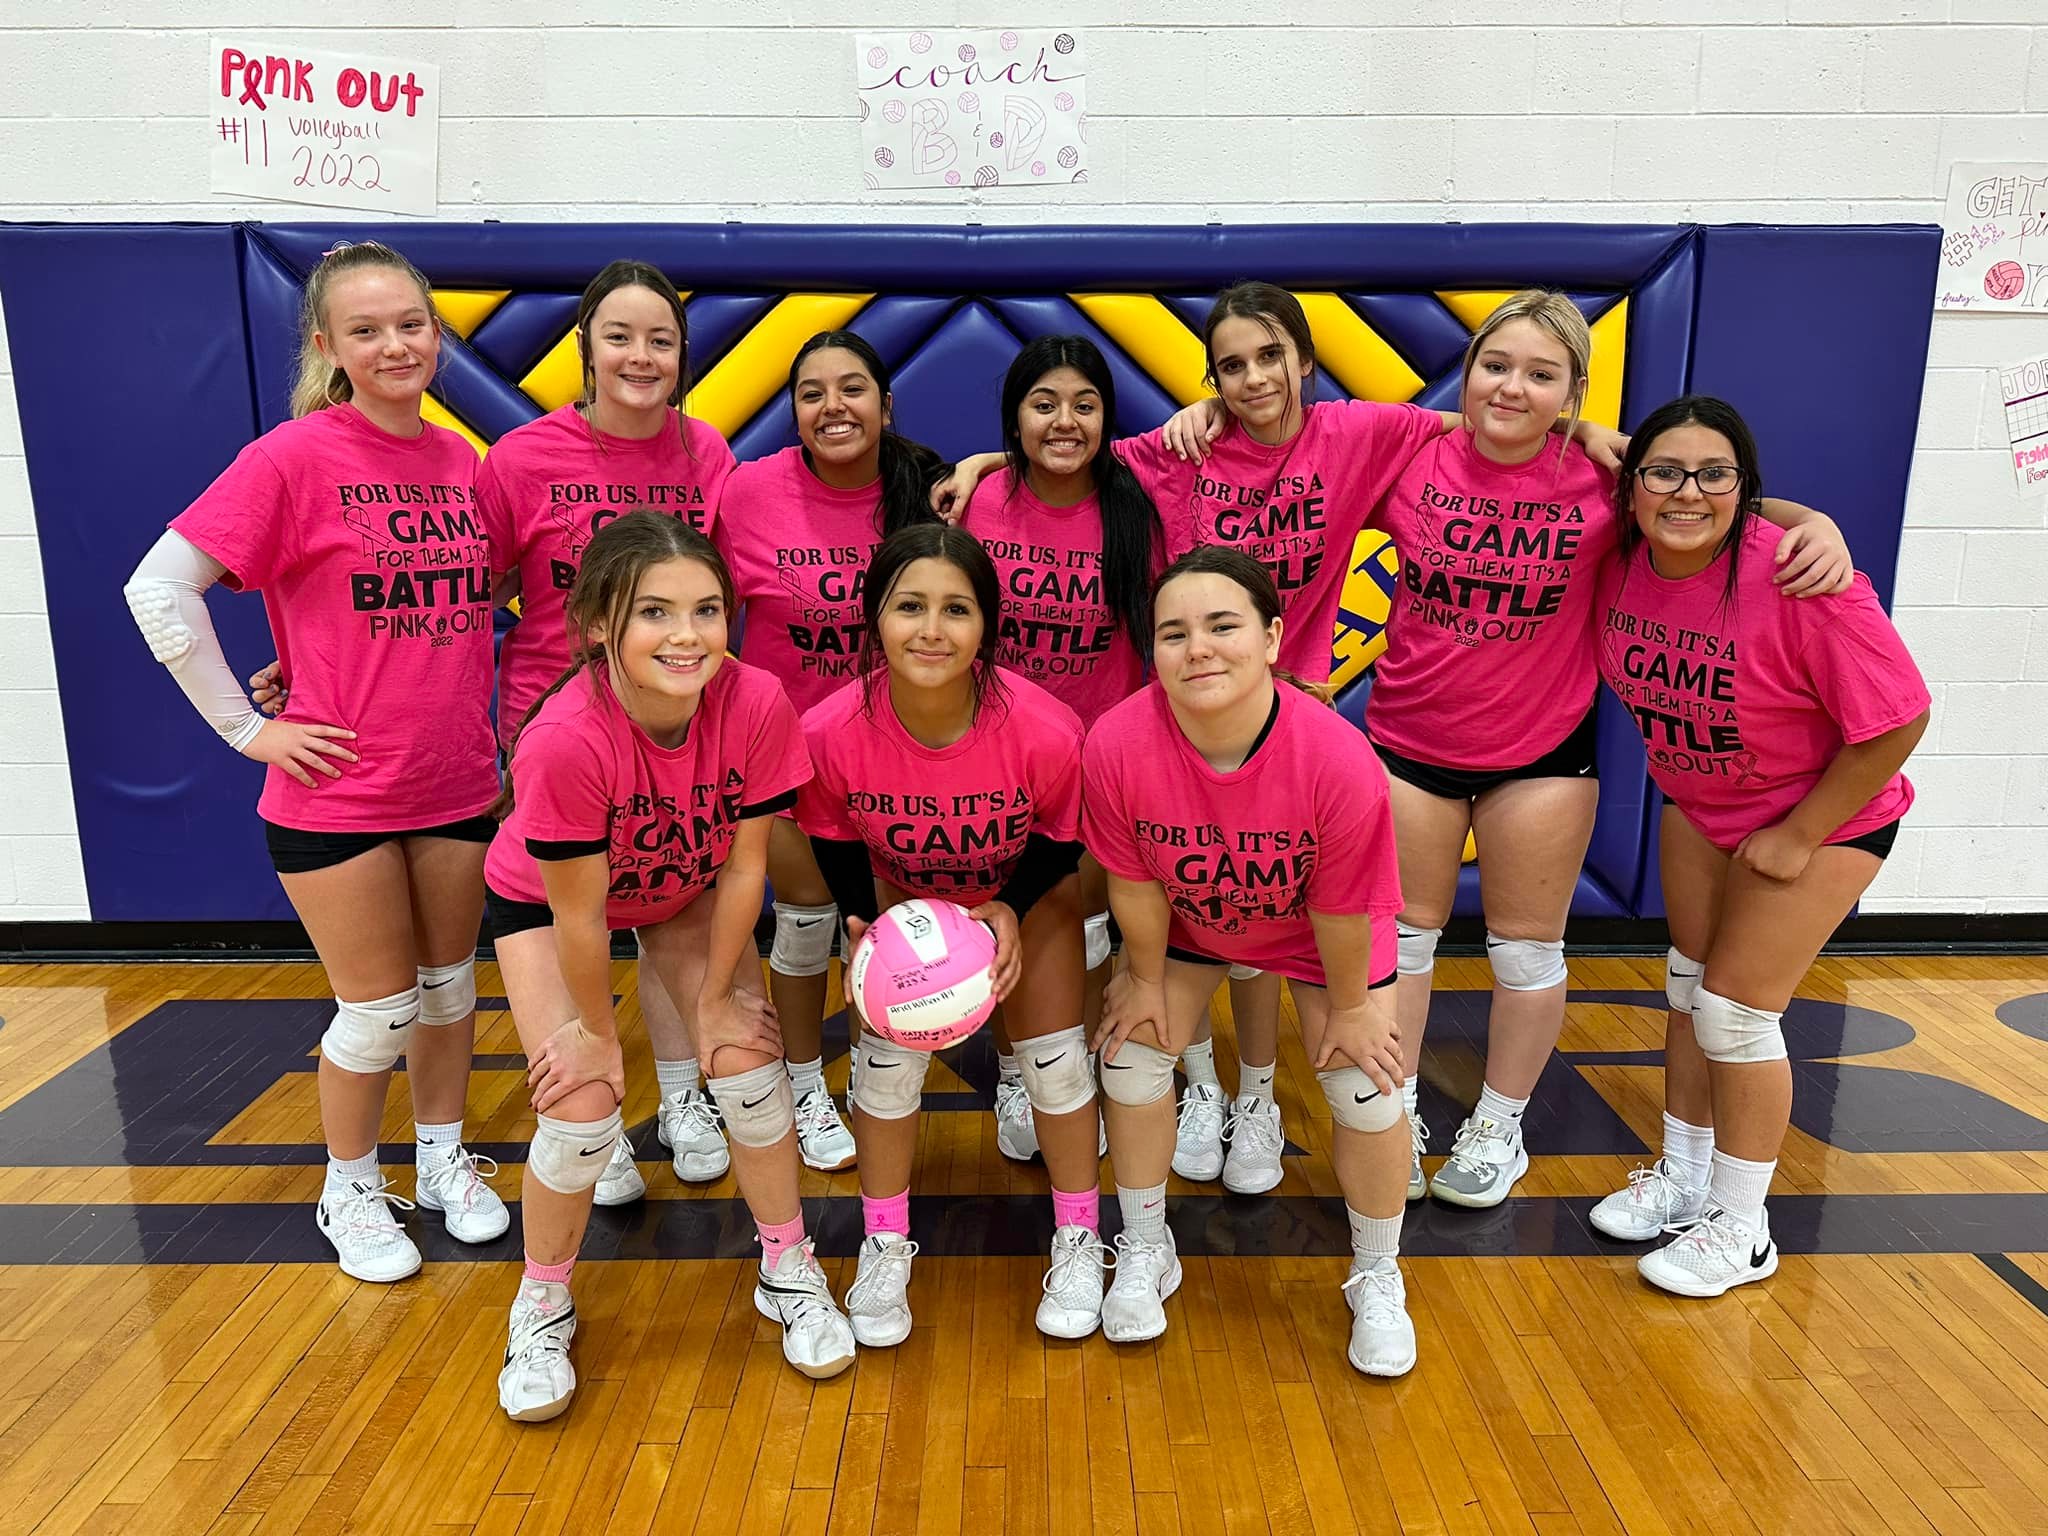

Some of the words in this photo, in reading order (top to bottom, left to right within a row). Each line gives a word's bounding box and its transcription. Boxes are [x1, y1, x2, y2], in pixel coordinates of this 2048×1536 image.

[858, 47, 1086, 90] coach
[292, 146, 391, 192] 2022
[1966, 175, 2048, 219] GET
[337, 484, 392, 506] FOR
[393, 484, 430, 507] US,
[430, 485, 465, 504] IT'S
[549, 484, 601, 503] FOR
[605, 484, 643, 505] US,
[647, 485, 688, 504] IT'S
[690, 486, 705, 503] A
[1309, 472, 1325, 494] A
[1420, 482, 1464, 513] FOR
[1467, 496, 1505, 522] US,
[1510, 501, 1562, 523] IT'S
[1564, 505, 1585, 523] A
[1214, 497, 1327, 542] GAME
[982, 539, 1024, 562] FOR
[1028, 545, 1061, 570] US,
[1065, 550, 1104, 570] IT'S
[1279, 537, 1311, 557] IT'S
[1316, 536, 1326, 549] A
[1443, 518, 1583, 562] GAME
[376, 550, 415, 568] FOR
[419, 548, 463, 566] THEM
[776, 548, 825, 567] FOR
[828, 546, 866, 566] US,
[1420, 547, 1457, 570] FOR
[1464, 557, 1515, 581] THEM
[1517, 564, 1554, 582] IT'S
[1559, 564, 1571, 580] A
[818, 570, 868, 602] GA
[1009, 567, 1100, 605] GAM
[1404, 557, 1567, 618] BATTLE
[369, 613, 435, 640] PINK
[450, 607, 489, 634] OUT
[803, 608, 841, 623] FOR
[1000, 601, 1024, 615] OR
[1029, 602, 1072, 622] THEM
[1409, 599, 1465, 634] PINK
[1481, 619, 1544, 642] OUT
[431, 636, 454, 648] 2022
[786, 623, 868, 655] BAT
[1001, 616, 1116, 655] ATTLE
[1454, 634, 1480, 648] 2022
[1606, 607, 1637, 636] FOR
[1641, 619, 1671, 650] US,
[1675, 629, 1719, 657] IT'S
[1719, 640, 1737, 662] A
[801, 656, 857, 678] PINK
[1023, 670, 1048, 681] 2022
[1049, 656, 1099, 676] OUT
[1623, 644, 1736, 703] GAME
[1612, 676, 1635, 699] FOR
[1640, 686, 1680, 714] THEM
[1684, 700, 1717, 722] IT'S
[1723, 708, 1737, 722] A
[1626, 702, 1744, 754] TTLE
[725, 767, 744, 788] A
[1671, 752, 1732, 776] OUT
[847, 791, 897, 816] FOR
[901, 794, 946, 821] US,
[952, 790, 1006, 817] IT'S
[1011, 786, 1030, 809] A
[886, 810, 1030, 855] GAME
[1135, 819, 1189, 848] FOR
[1237, 830, 1291, 853] IT'S
[1296, 830, 1317, 849] A
[917, 857, 972, 869] THEM
[1174, 850, 1317, 890] GAME
[1167, 885, 1199, 898] OR
